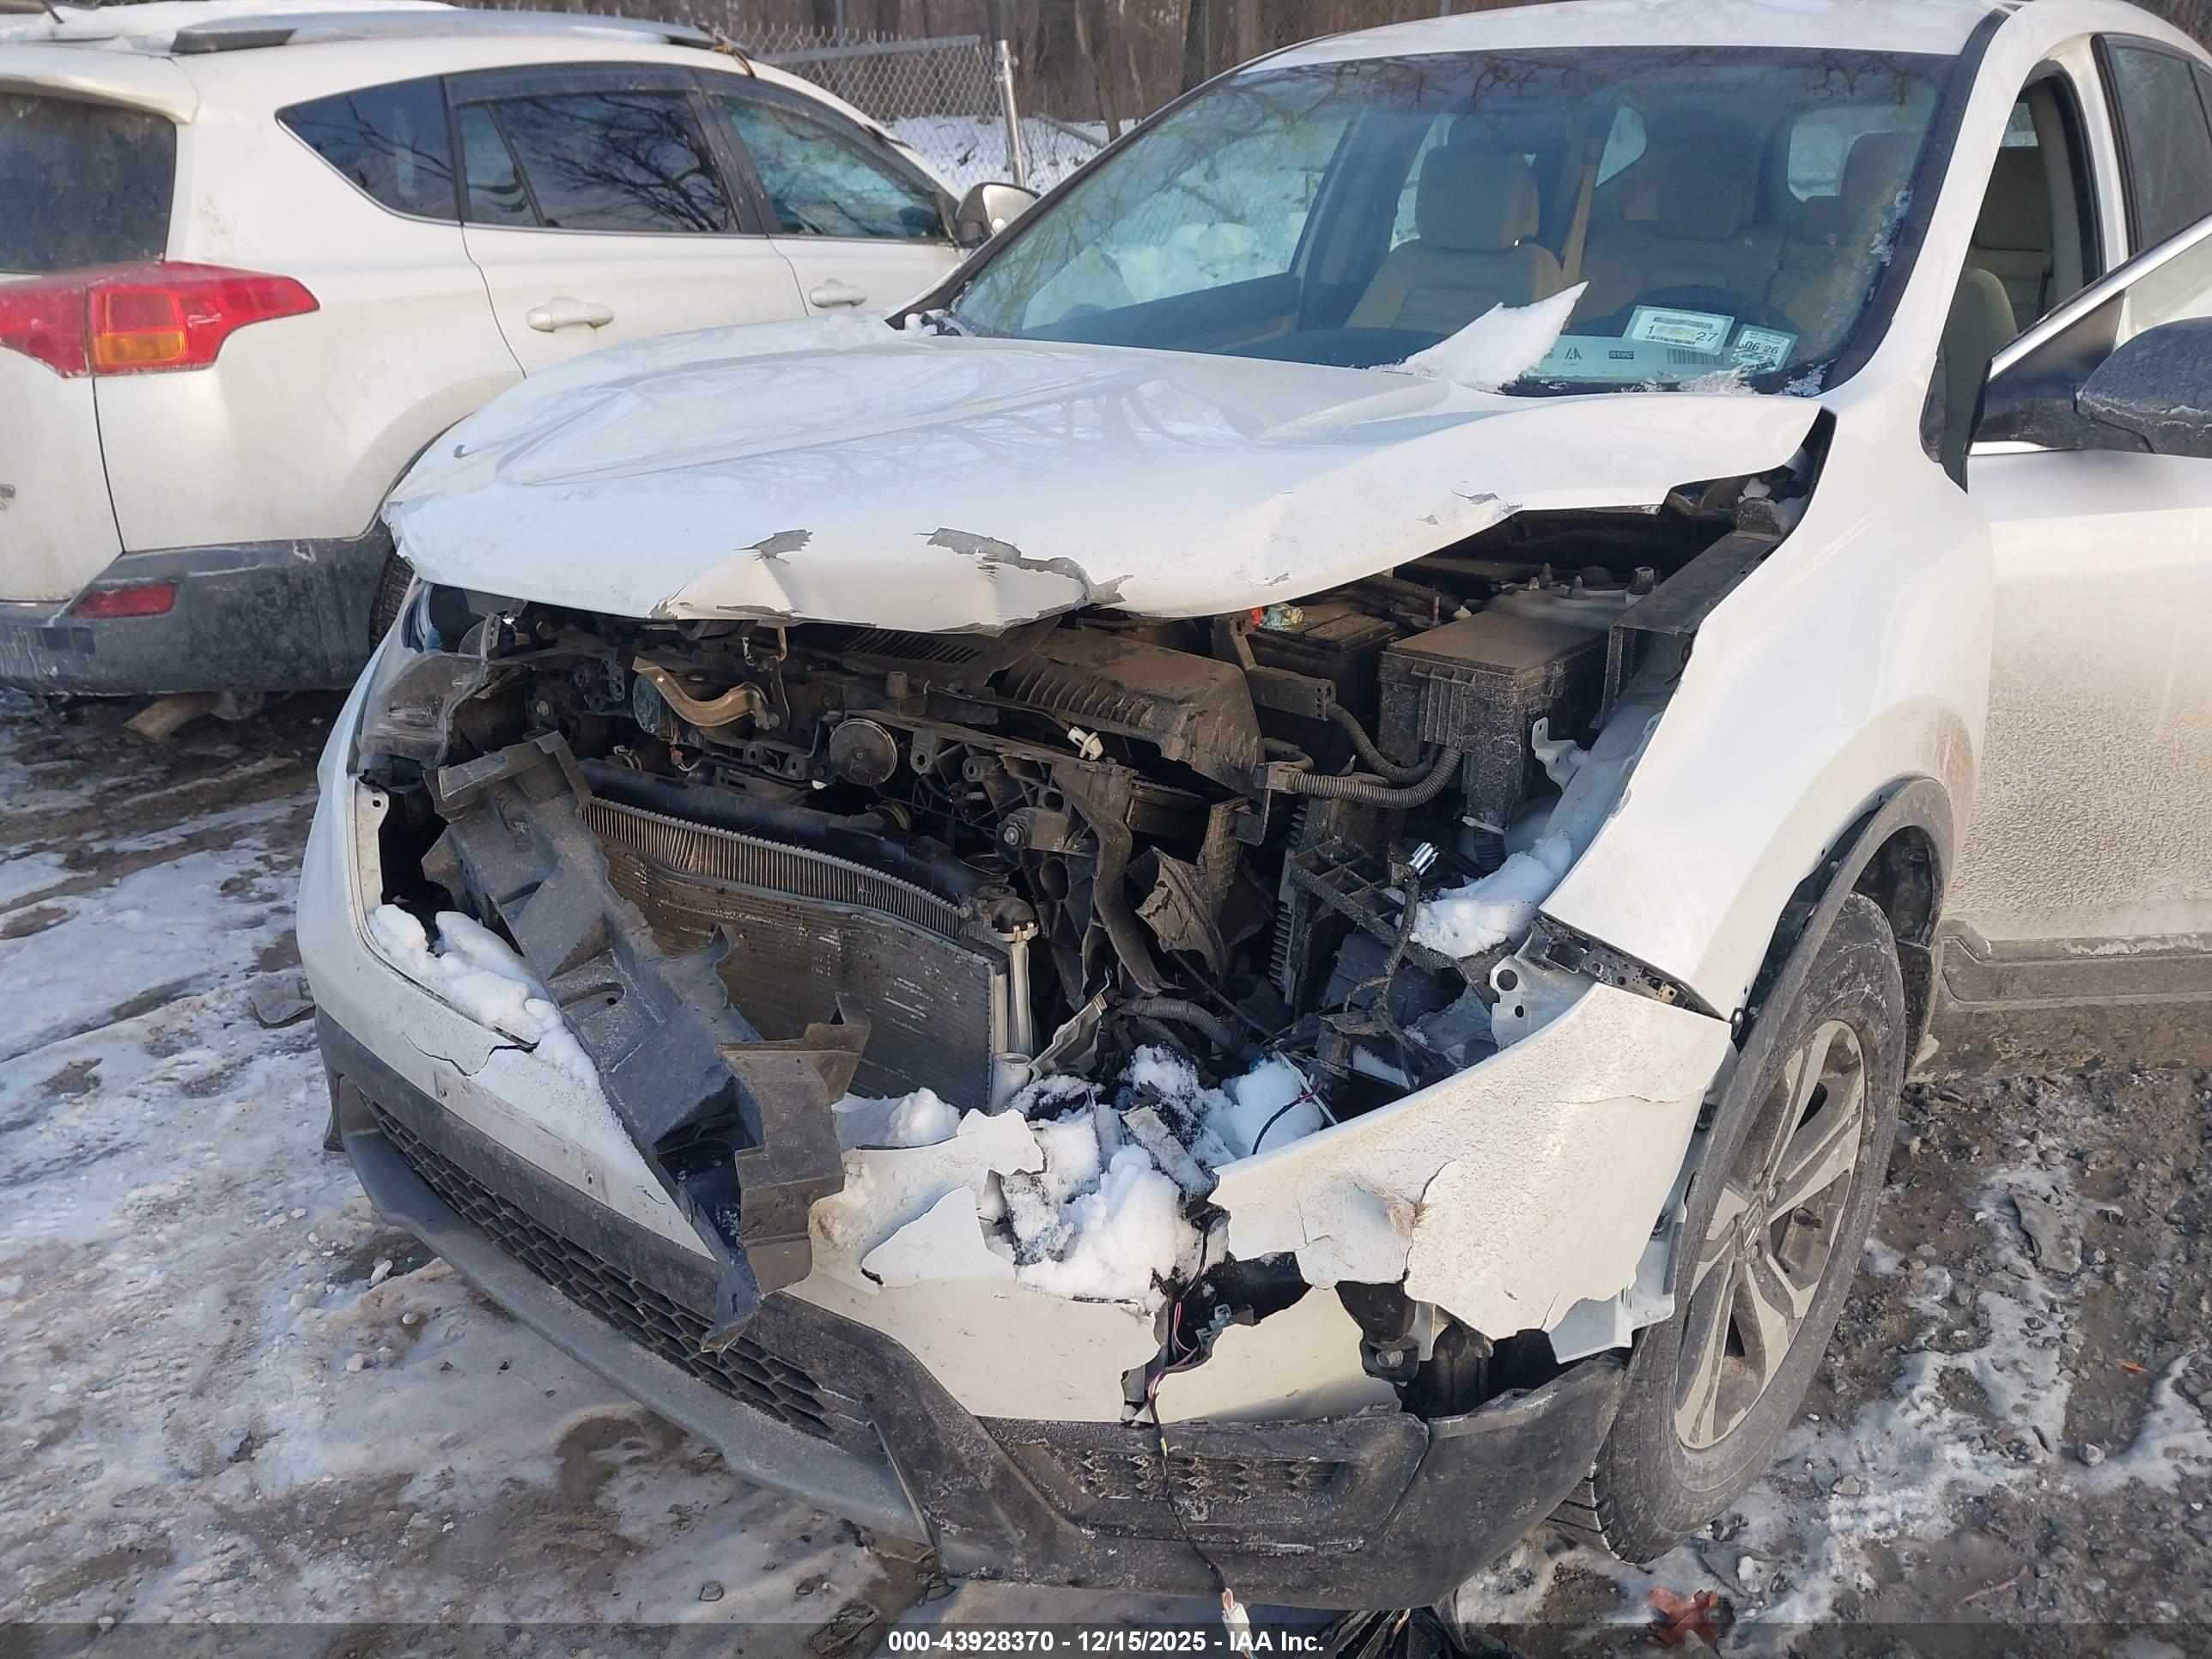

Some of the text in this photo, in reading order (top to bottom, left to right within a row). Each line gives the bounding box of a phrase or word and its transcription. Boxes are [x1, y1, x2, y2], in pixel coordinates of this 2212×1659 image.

[1695, 331, 1719, 342] 27
[1745, 340, 1779, 355] 06 26
